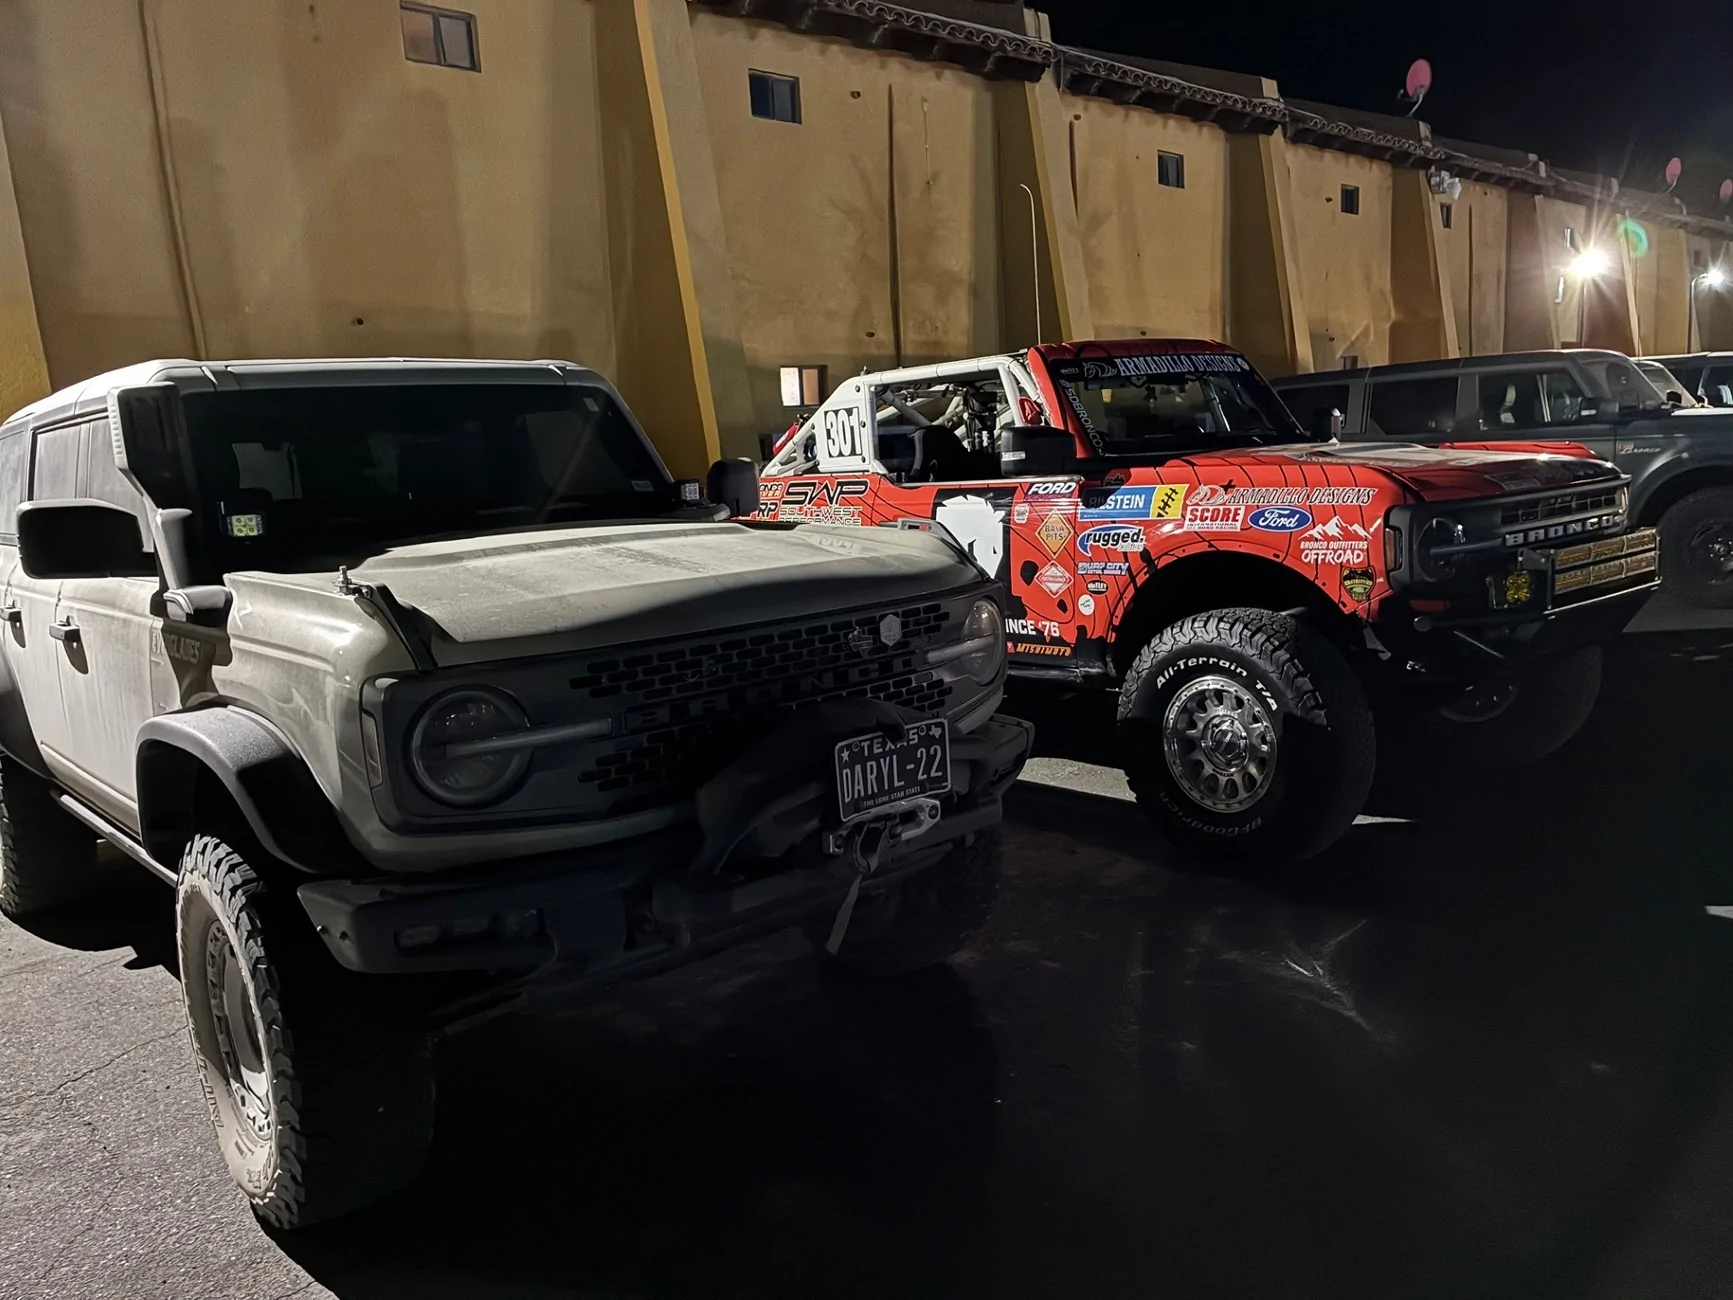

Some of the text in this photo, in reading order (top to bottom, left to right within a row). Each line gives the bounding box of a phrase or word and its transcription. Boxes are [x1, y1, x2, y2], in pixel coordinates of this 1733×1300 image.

[1114, 354, 1241, 377] ARMADILLO DESIGNS
[826, 407, 862, 457] 301
[1028, 482, 1076, 494] FORD
[1227, 488, 1377, 505] ARMADILLO DESIGNS
[779, 507, 862, 517] SOUTHWEST
[1188, 508, 1241, 522] SCORE
[1258, 508, 1299, 528] Ford
[1505, 515, 1614, 547] BRONCO
[1300, 541, 1367, 549] BRONCO OUTFITTERS
[1301, 550, 1364, 564] OFFROAD
[1106, 562, 1129, 576] CITY
[1016, 643, 1071, 657] MISHIMOTO
[1157, 656, 1278, 711] All-Terrain T/A
[863, 786, 920, 808] THE LONE STAR STATE
